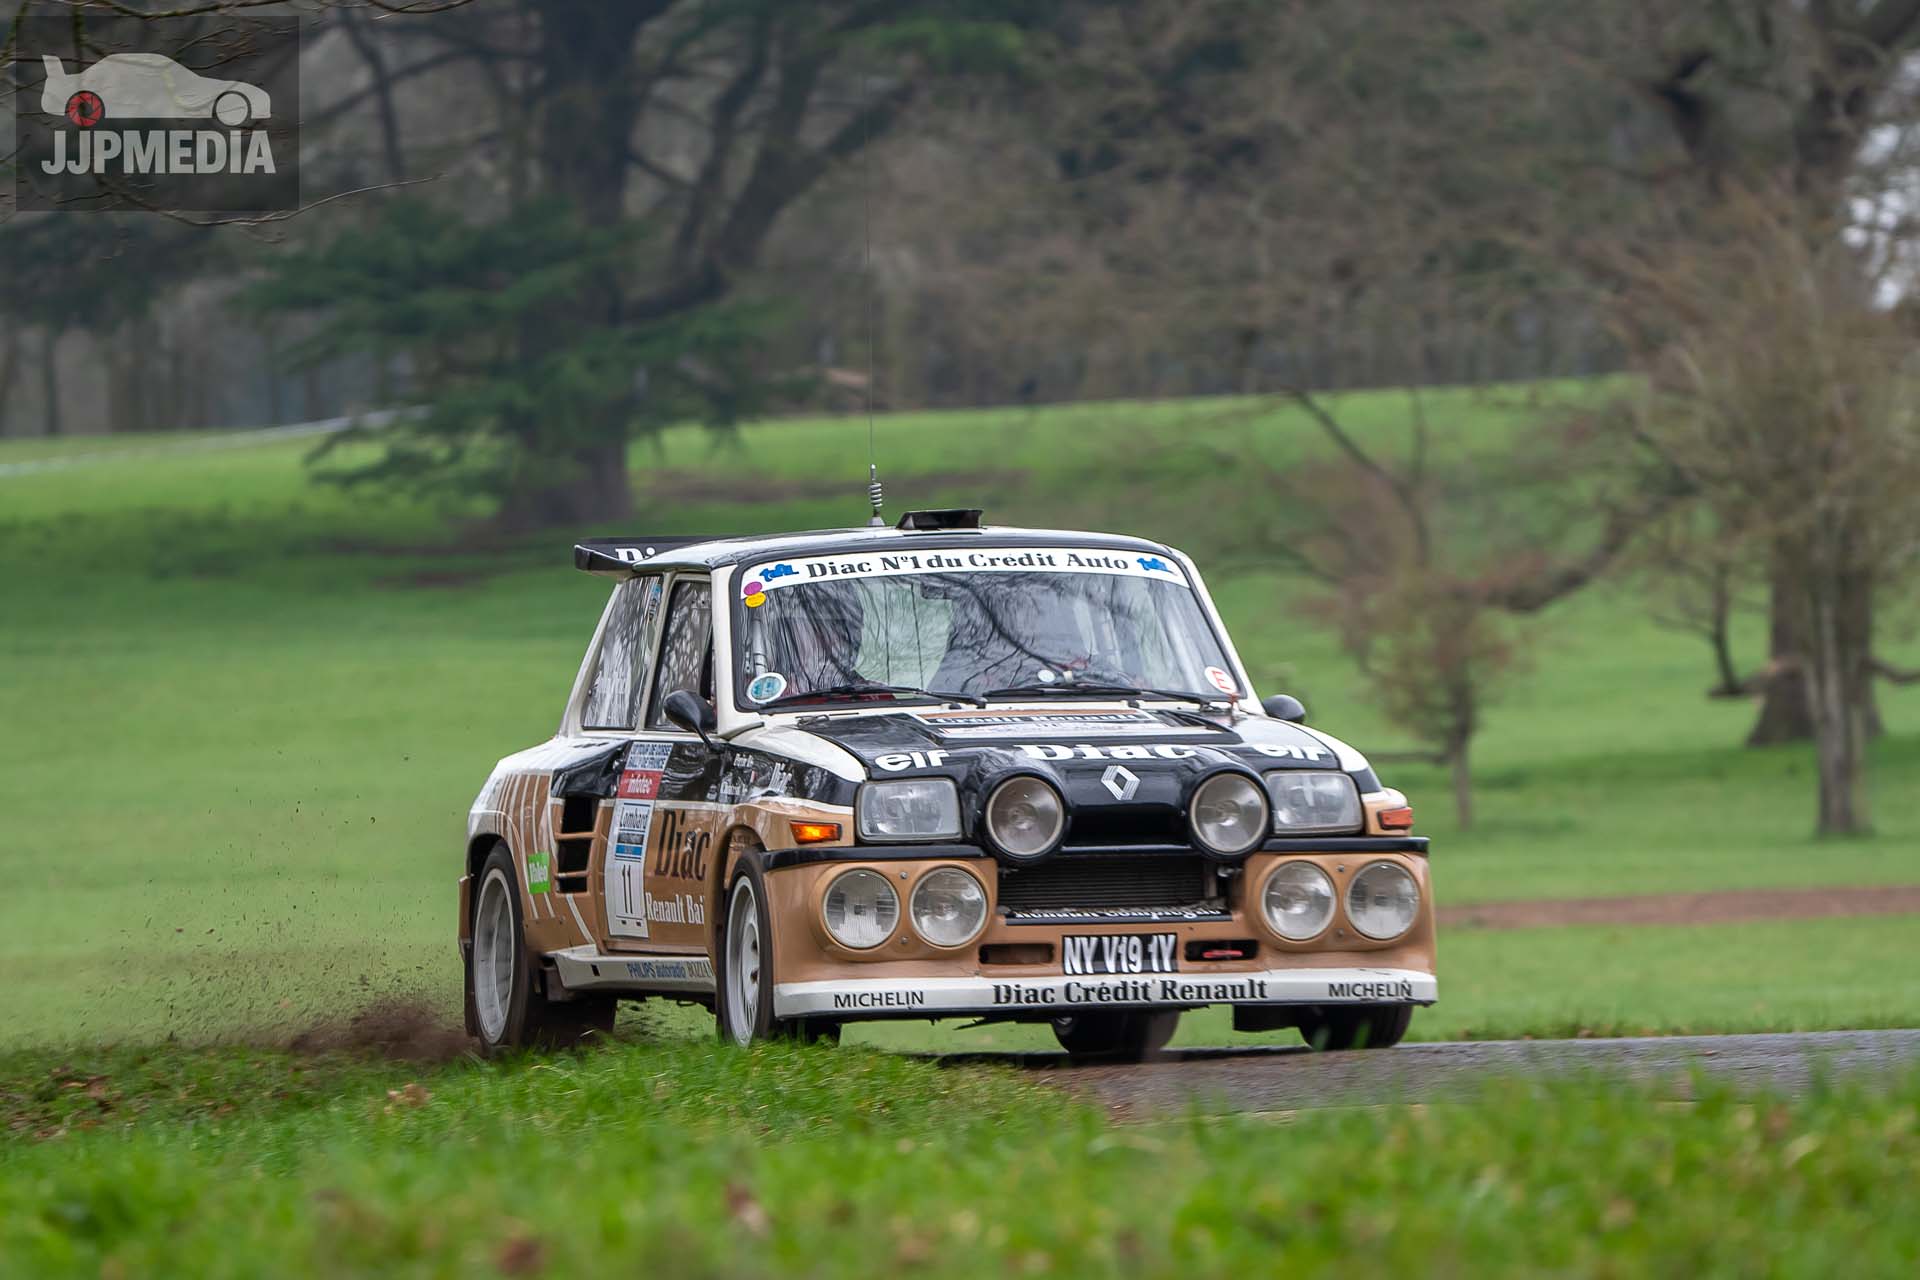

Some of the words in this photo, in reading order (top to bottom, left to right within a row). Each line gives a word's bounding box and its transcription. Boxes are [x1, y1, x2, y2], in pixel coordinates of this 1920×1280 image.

[806, 562, 872, 578] Diac
[926, 555, 963, 568] du
[1067, 553, 1128, 570] Auto
[874, 750, 950, 772] elf
[1013, 744, 1197, 760] Diac
[1252, 744, 1327, 761] elf
[655, 810, 710, 880] Diac
[622, 864, 633, 914] 11
[645, 892, 686, 924] Renault
[834, 991, 924, 1009] MICHELIN
[993, 984, 1055, 1004] Diac
[1064, 980, 1150, 1003] Crédit
[1159, 978, 1267, 1000] Renault
[1328, 982, 1412, 998] MICHELIN
